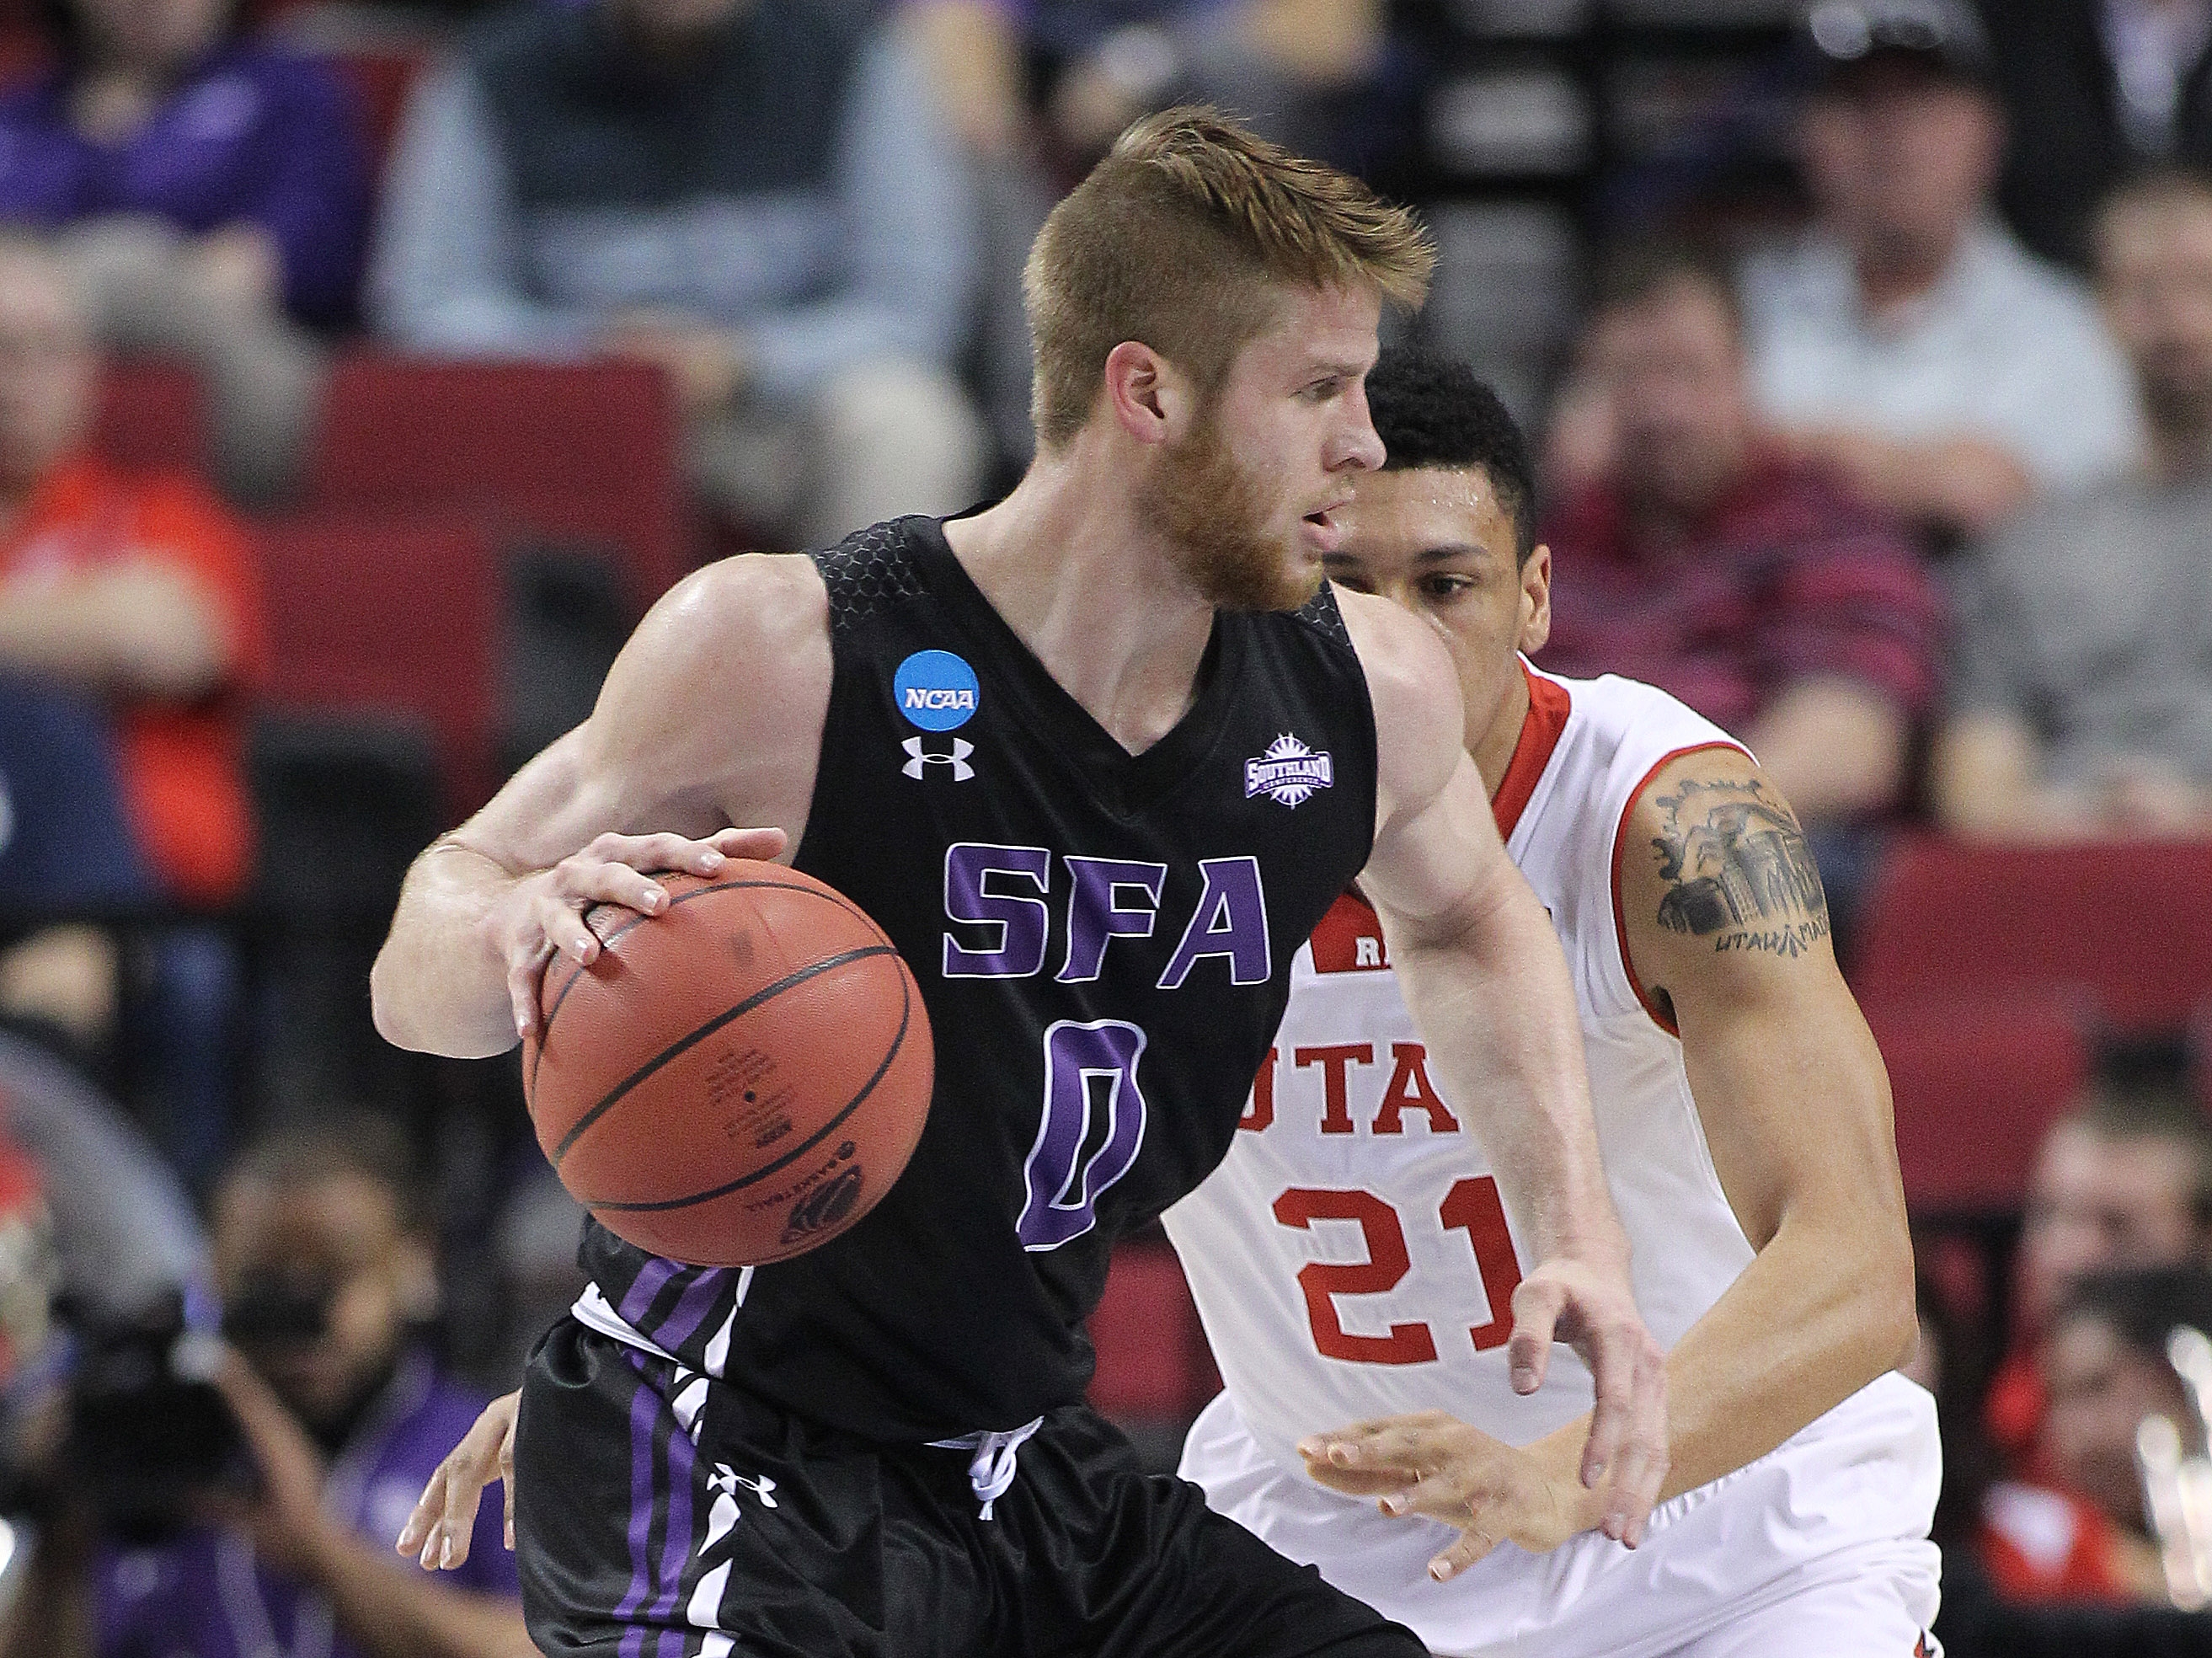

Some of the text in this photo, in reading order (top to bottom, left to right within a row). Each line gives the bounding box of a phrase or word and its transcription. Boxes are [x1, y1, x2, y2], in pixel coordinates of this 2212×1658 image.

[905, 687, 975, 709] NCAA
[1248, 756, 1331, 793] SOUTHLAND
[942, 842, 1271, 989] SFA
[1715, 931, 1779, 953] UTAH
[1239, 1043, 1459, 1134] UTA
[1016, 1019, 1147, 1253] 0
[1273, 1176, 1522, 1366] 21
